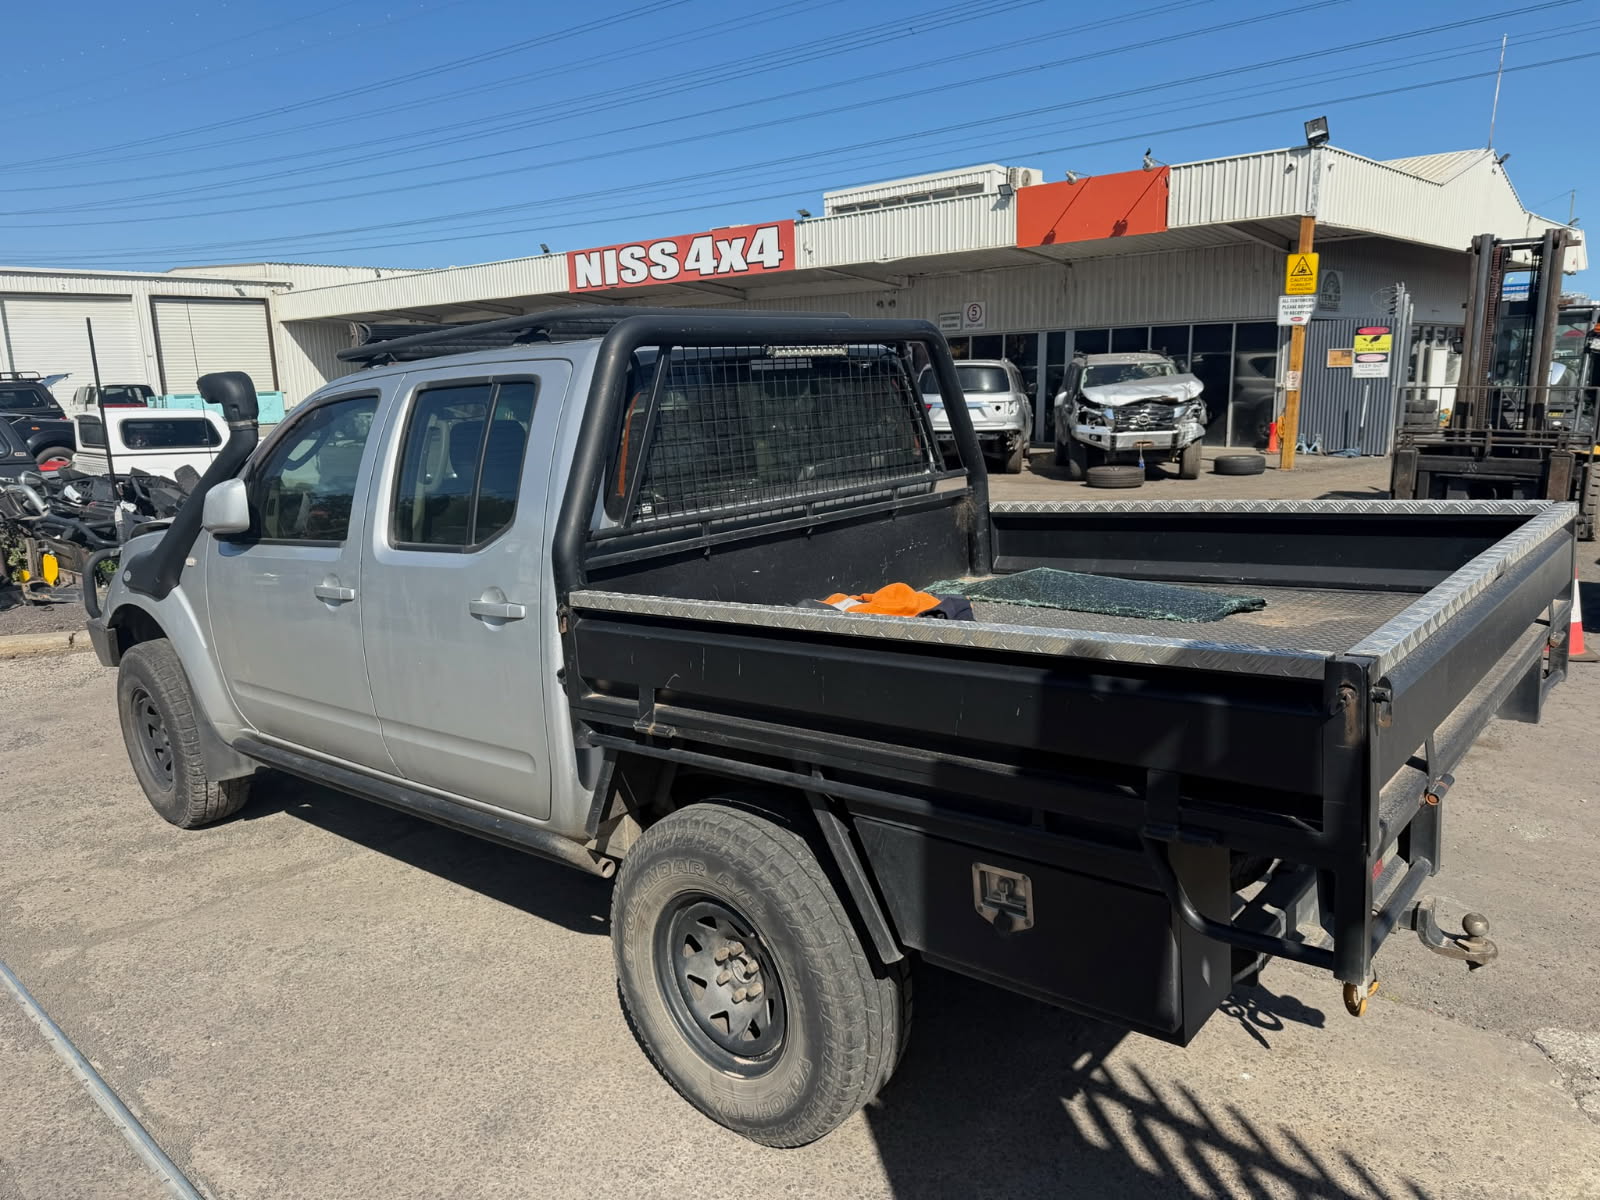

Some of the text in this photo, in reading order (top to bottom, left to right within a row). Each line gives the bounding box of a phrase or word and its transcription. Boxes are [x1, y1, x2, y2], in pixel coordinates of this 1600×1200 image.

[574, 225, 784, 289] NISS 4x4
[971, 306, 977, 316] 5
